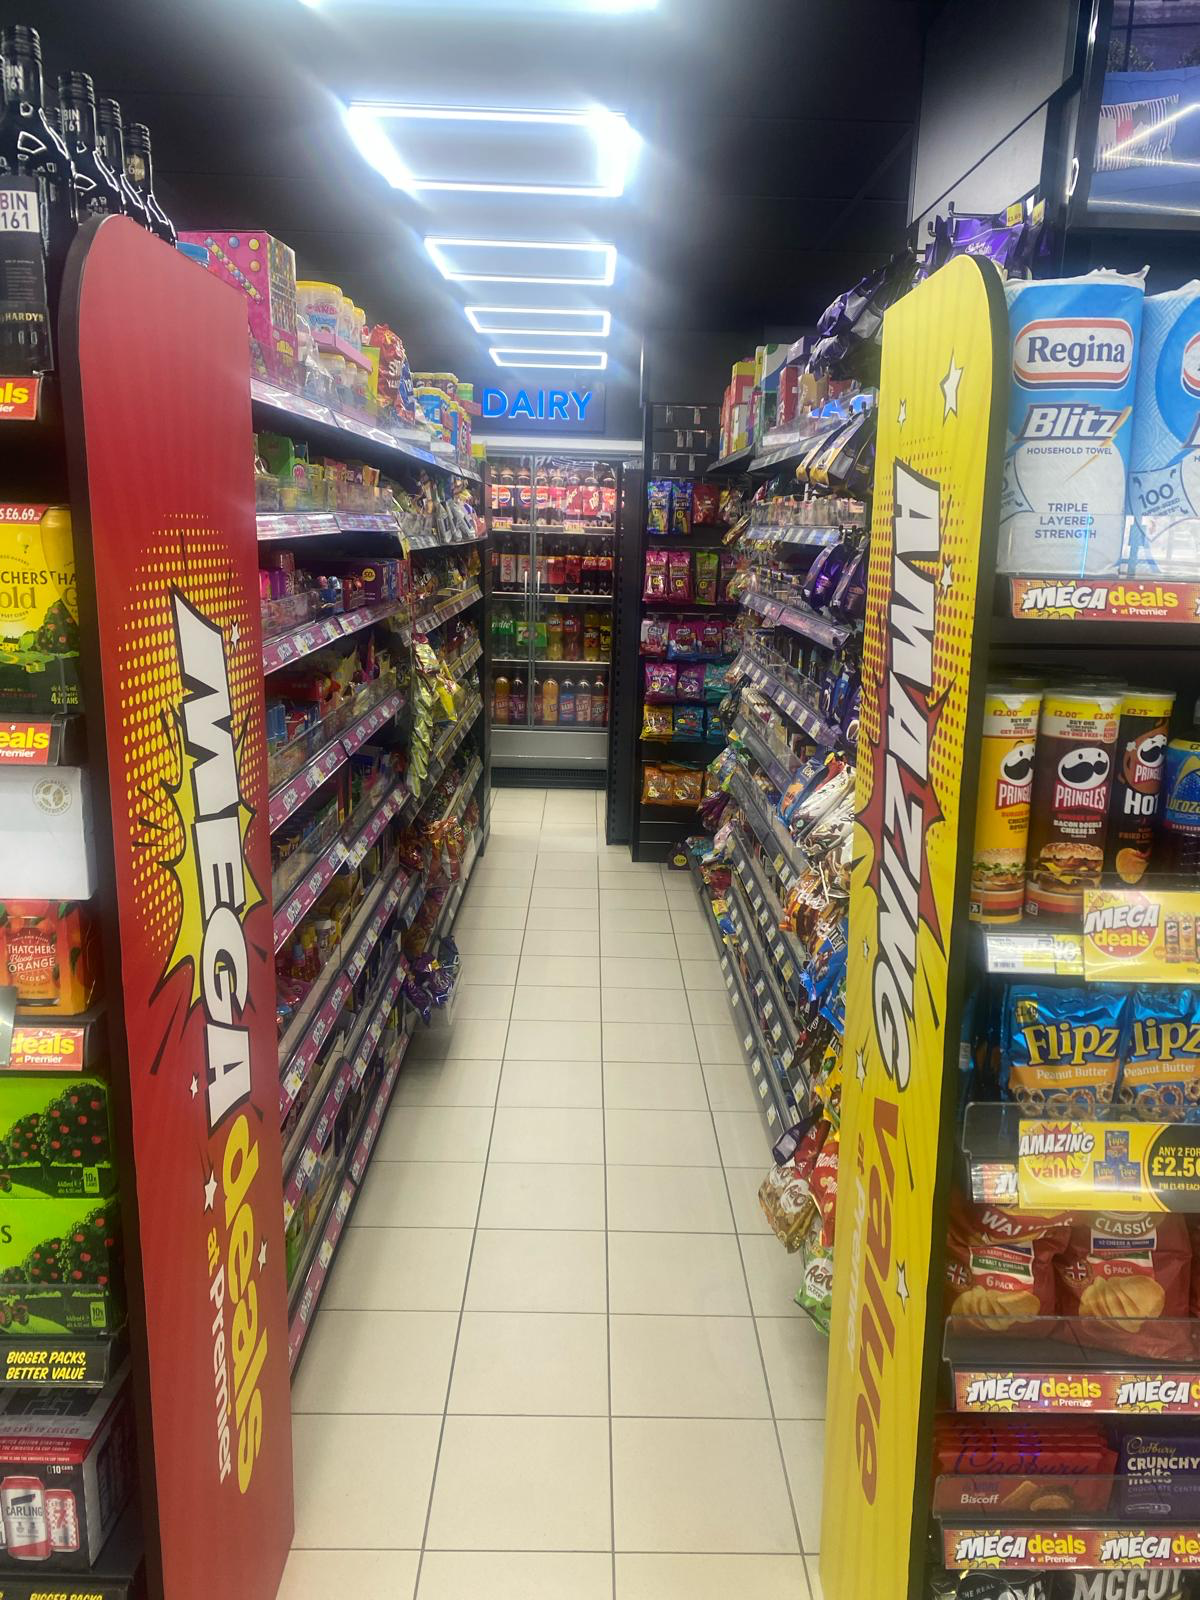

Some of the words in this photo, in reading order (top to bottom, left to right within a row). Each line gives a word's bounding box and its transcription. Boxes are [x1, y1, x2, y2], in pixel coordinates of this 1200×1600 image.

[5, 65, 23, 78] BIN
[63, 109, 80, 120] BIN
[0, 193, 28, 210] BIN
[1, 212, 29, 229] 161
[1027, 335, 1124, 367] Regina
[483, 388, 593, 420] DAIRY
[1023, 406, 1119, 438] Blitz
[1027, 447, 1083, 455] HOUSEHOLD
[1086, 447, 1112, 455] TOWEL
[1139, 483, 1173, 508] 100
[6, 509, 34, 520] £6.69
[1048, 503, 1088, 512] TRIPLE
[1040, 516, 1095, 525] LAYERED
[1035, 530, 1096, 539] STRENGTH
[1022, 586, 1108, 610] MEGA
[1109, 587, 1179, 607] deals
[1129, 607, 1167, 616] Premier
[993, 709, 1018, 717] £2.00
[1054, 710, 1077, 719] £2.00
[1127, 708, 1148, 716] £2.75
[874, 465, 941, 1094] AMAZING
[1055, 784, 1105, 810] PRINGLES
[1053, 819, 1078, 827] BACON
[1084, 903, 1160, 934] MEGA
[1094, 929, 1149, 947] deals
[8, 944, 56, 954] THATCHERS
[8, 957, 56, 974] ORANGE
[9, 954, 33, 964] Blood
[174, 592, 252, 1128] MEGA
[223, 1114, 268, 1494] deals
[1022, 1022, 1120, 1066] Flipz
[24, 1055, 62, 1065] Premier
[1036, 1068, 1072, 1080] Peanut
[1075, 1067, 1107, 1078] Butter
[1162, 1063, 1195, 1074] Butter
[1020, 1133, 1095, 1156] AMAZING
[1159, 1146, 1176, 1156] ANY
[1177, 1147, 1183, 1157] 2
[1031, 1165, 1082, 1180] value
[1095, 1216, 1154, 1236] CLASSIC
[207, 1227, 221, 1277] at
[848, 1177, 865, 1372] Premier
[1104, 1264, 1112, 1276] 6
[1112, 1266, 1133, 1274] PACK
[986, 1276, 994, 1287] 6
[995, 1280, 1014, 1290] PACK
[856, 1098, 899, 1505] value
[6, 1352, 46, 1364] BIGGER
[49, 1352, 87, 1366] PACKS,
[6, 1367, 48, 1380] BETTER
[51, 1367, 86, 1380] VALUE
[210, 1264, 231, 1484] Premier
[967, 1378, 1042, 1404] MEGA
[1042, 1377, 1102, 1398] deals
[1117, 1381, 1191, 1405] MEGA
[1059, 1399, 1093, 1408] Premier
[1127, 1437, 1176, 1457] Cadbury
[52, 1465, 61, 1474] 10
[1127, 1457, 1200, 1471] CRUNCHY
[1128, 1468, 1172, 1486] melts
[960, 1493, 999, 1504] Biscoff
[6, 1506, 43, 1518] CARLING
[955, 1535, 1028, 1561] MEGA
[1028, 1535, 1086, 1555] deals
[1101, 1536, 1172, 1561] MEGA
[1045, 1555, 1077, 1564] Premier
